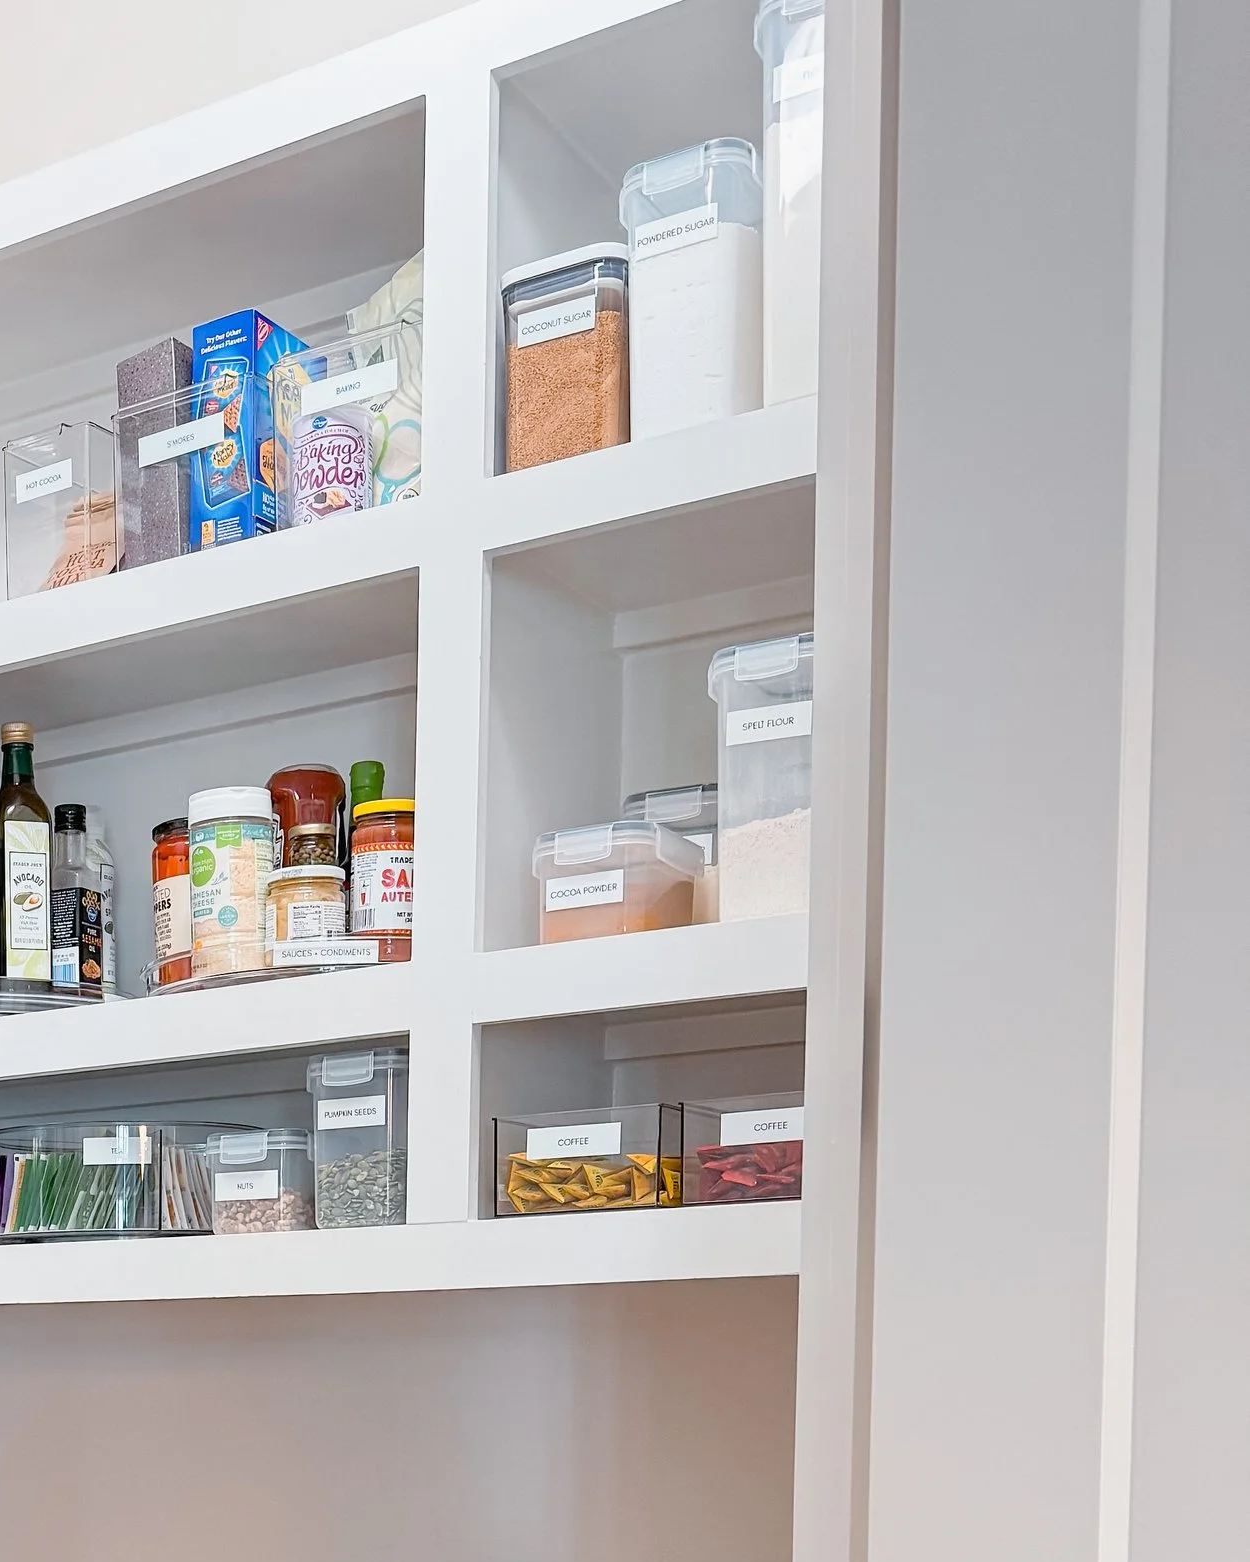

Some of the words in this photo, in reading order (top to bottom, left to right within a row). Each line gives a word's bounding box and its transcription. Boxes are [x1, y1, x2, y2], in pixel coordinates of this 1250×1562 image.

[637, 226, 683, 248] POWDERED
[684, 216, 715, 233] SUGAR
[521, 317, 562, 336] COCONUT
[563, 310, 592, 326] SUGAR
[335, 381, 362, 395] BAKING
[166, 433, 195, 448] S'MORES
[298, 438, 357, 472] Baking
[25, 480, 38, 490] HOT
[38, 474, 62, 487] COCOA
[65, 548, 106, 568] HOT
[741, 718, 764, 732] SPELT
[766, 716, 795, 728] FLOUR
[192, 864, 214, 876] rganic
[13, 873, 44, 887] AVOCADO
[381, 868, 413, 889] SA
[550, 887, 582, 899] COCOA
[583, 881, 618, 896] POWDER
[281, 948, 313, 959] SAUCES
[320, 947, 371, 957] CONDIMENTS
[324, 1109, 353, 1119] PUMPKIN
[354, 1107, 377, 1116] SEEDS
[753, 1120, 789, 1132] COFFEE
[557, 1136, 590, 1147] COFFEE
[236, 1182, 254, 1191] NUTS
